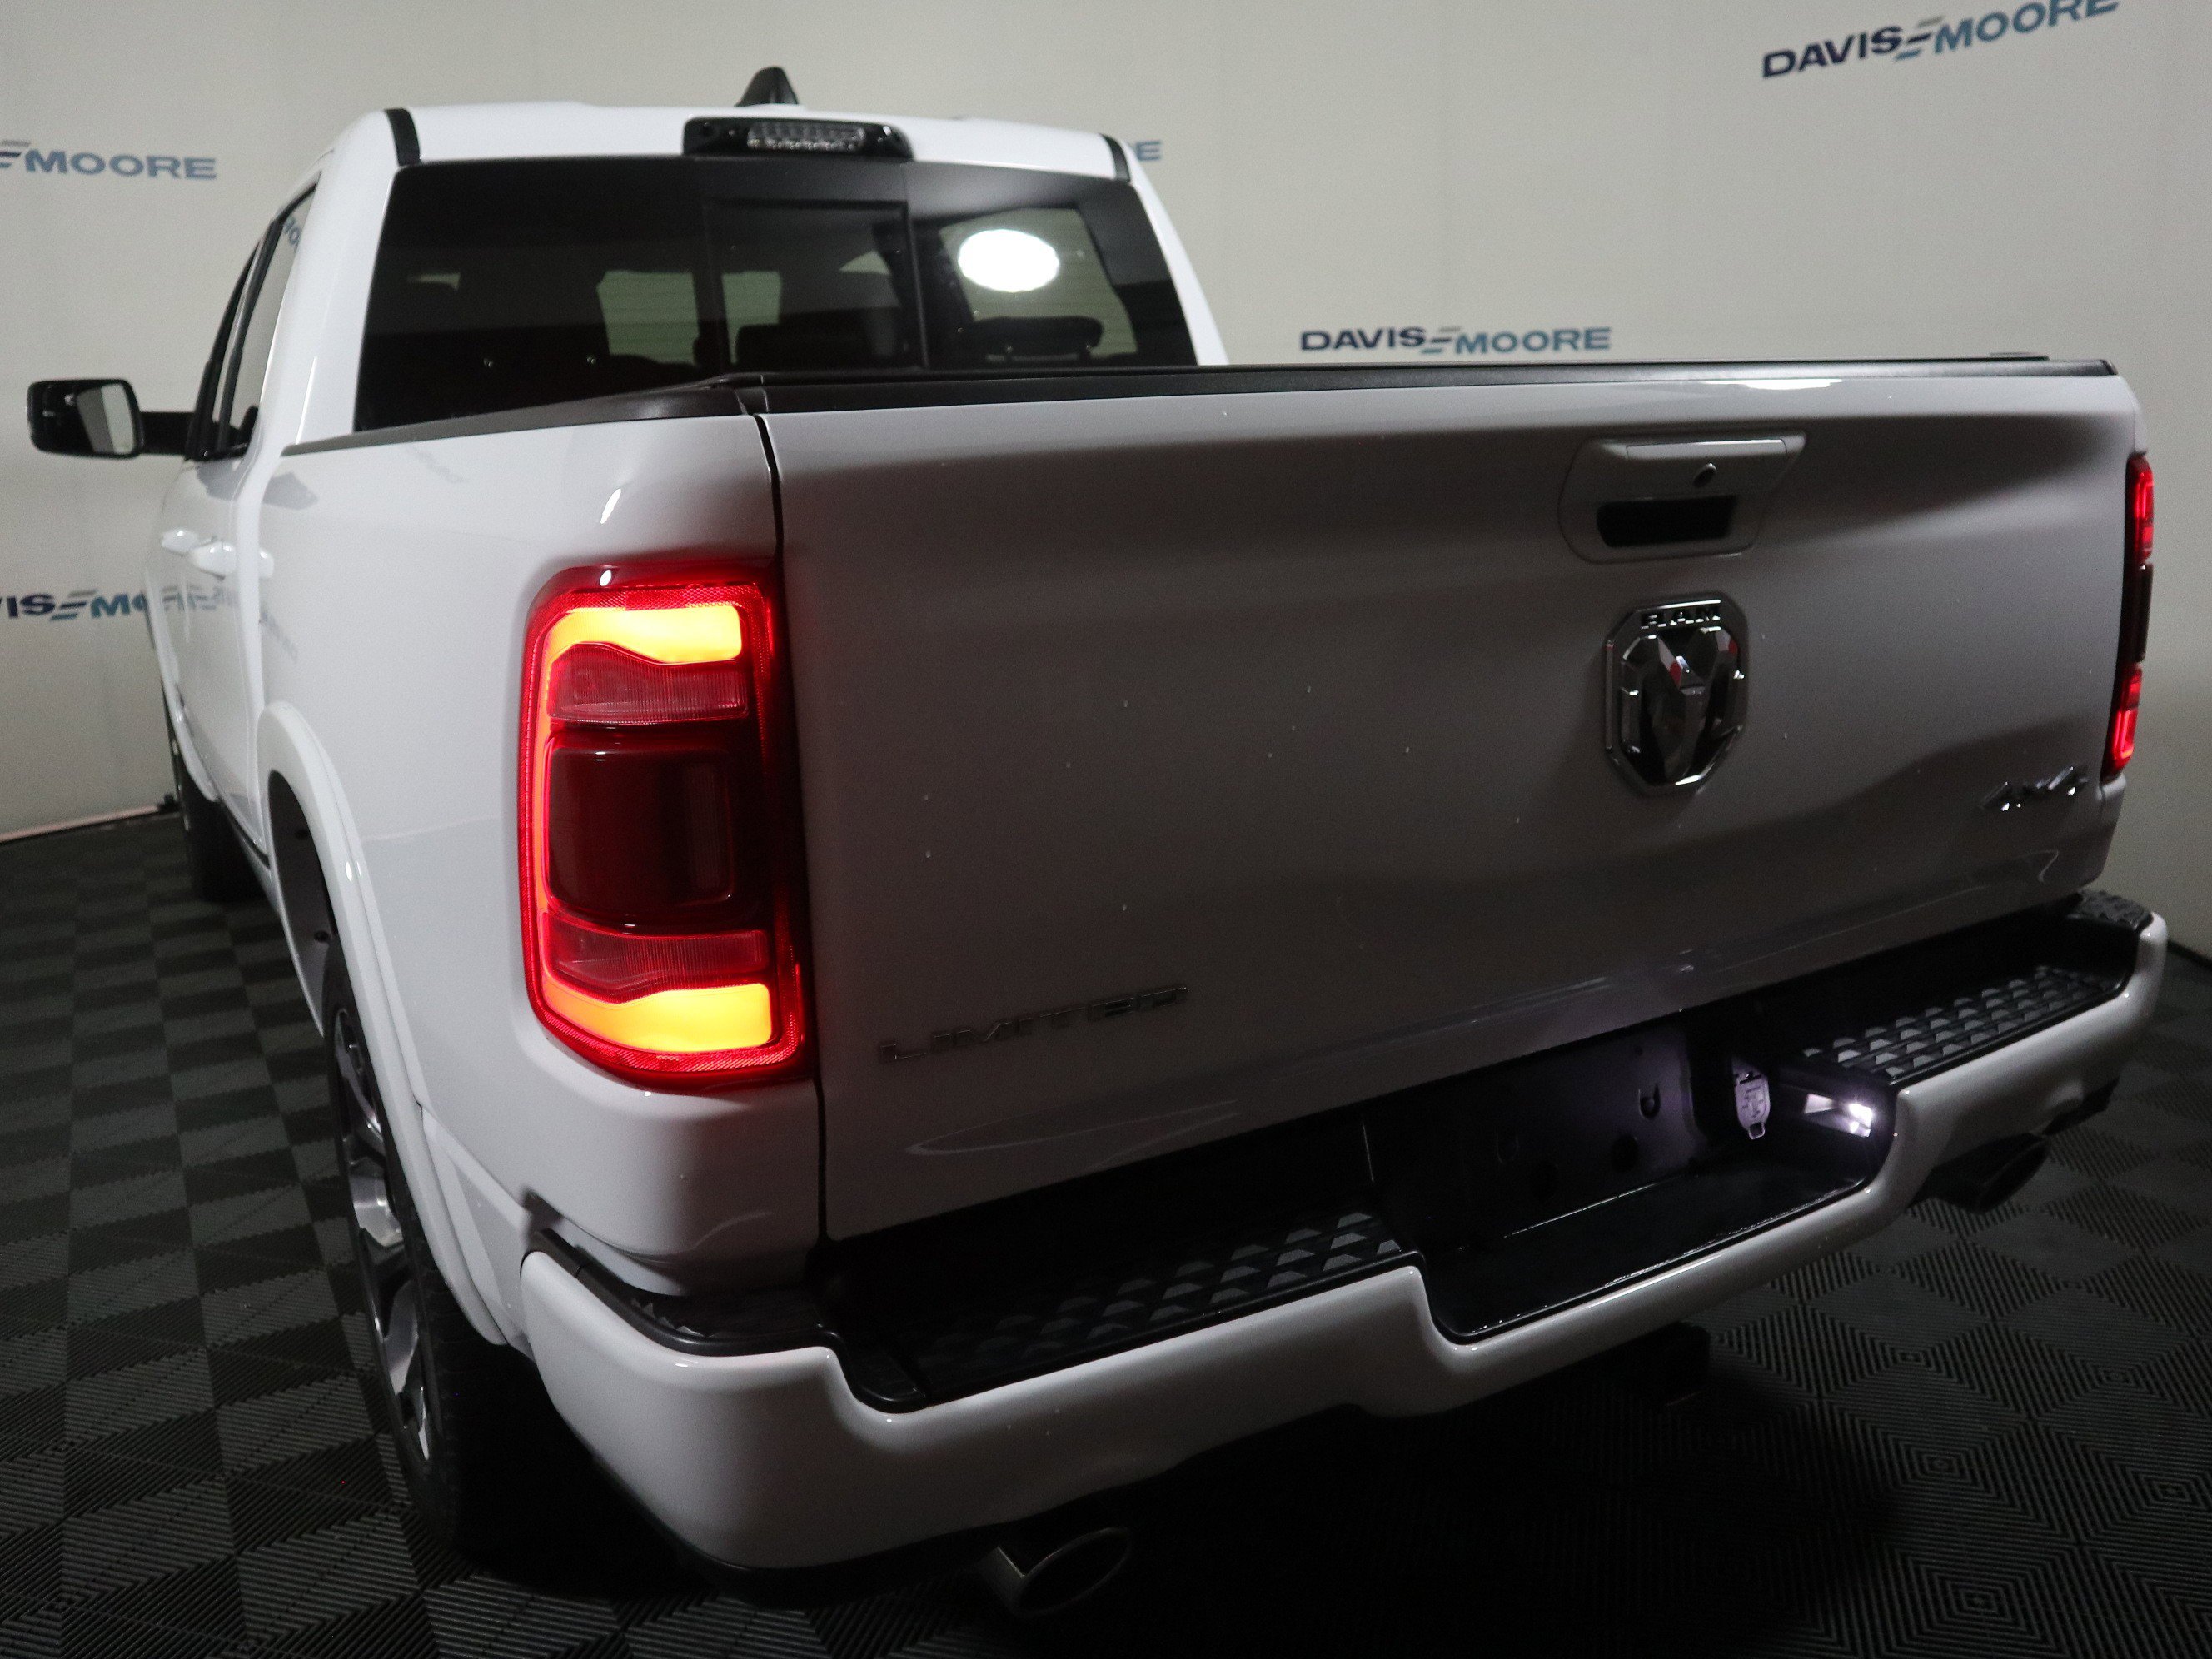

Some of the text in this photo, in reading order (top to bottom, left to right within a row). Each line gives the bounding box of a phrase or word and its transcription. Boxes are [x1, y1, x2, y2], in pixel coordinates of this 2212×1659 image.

[1761, 0, 2120, 78] DAVIS MOORE
[24, 148, 217, 180] MOORE
[1300, 326, 1612, 355] DAVIS MOORE
[878, 984, 1190, 1065] LIMITED
